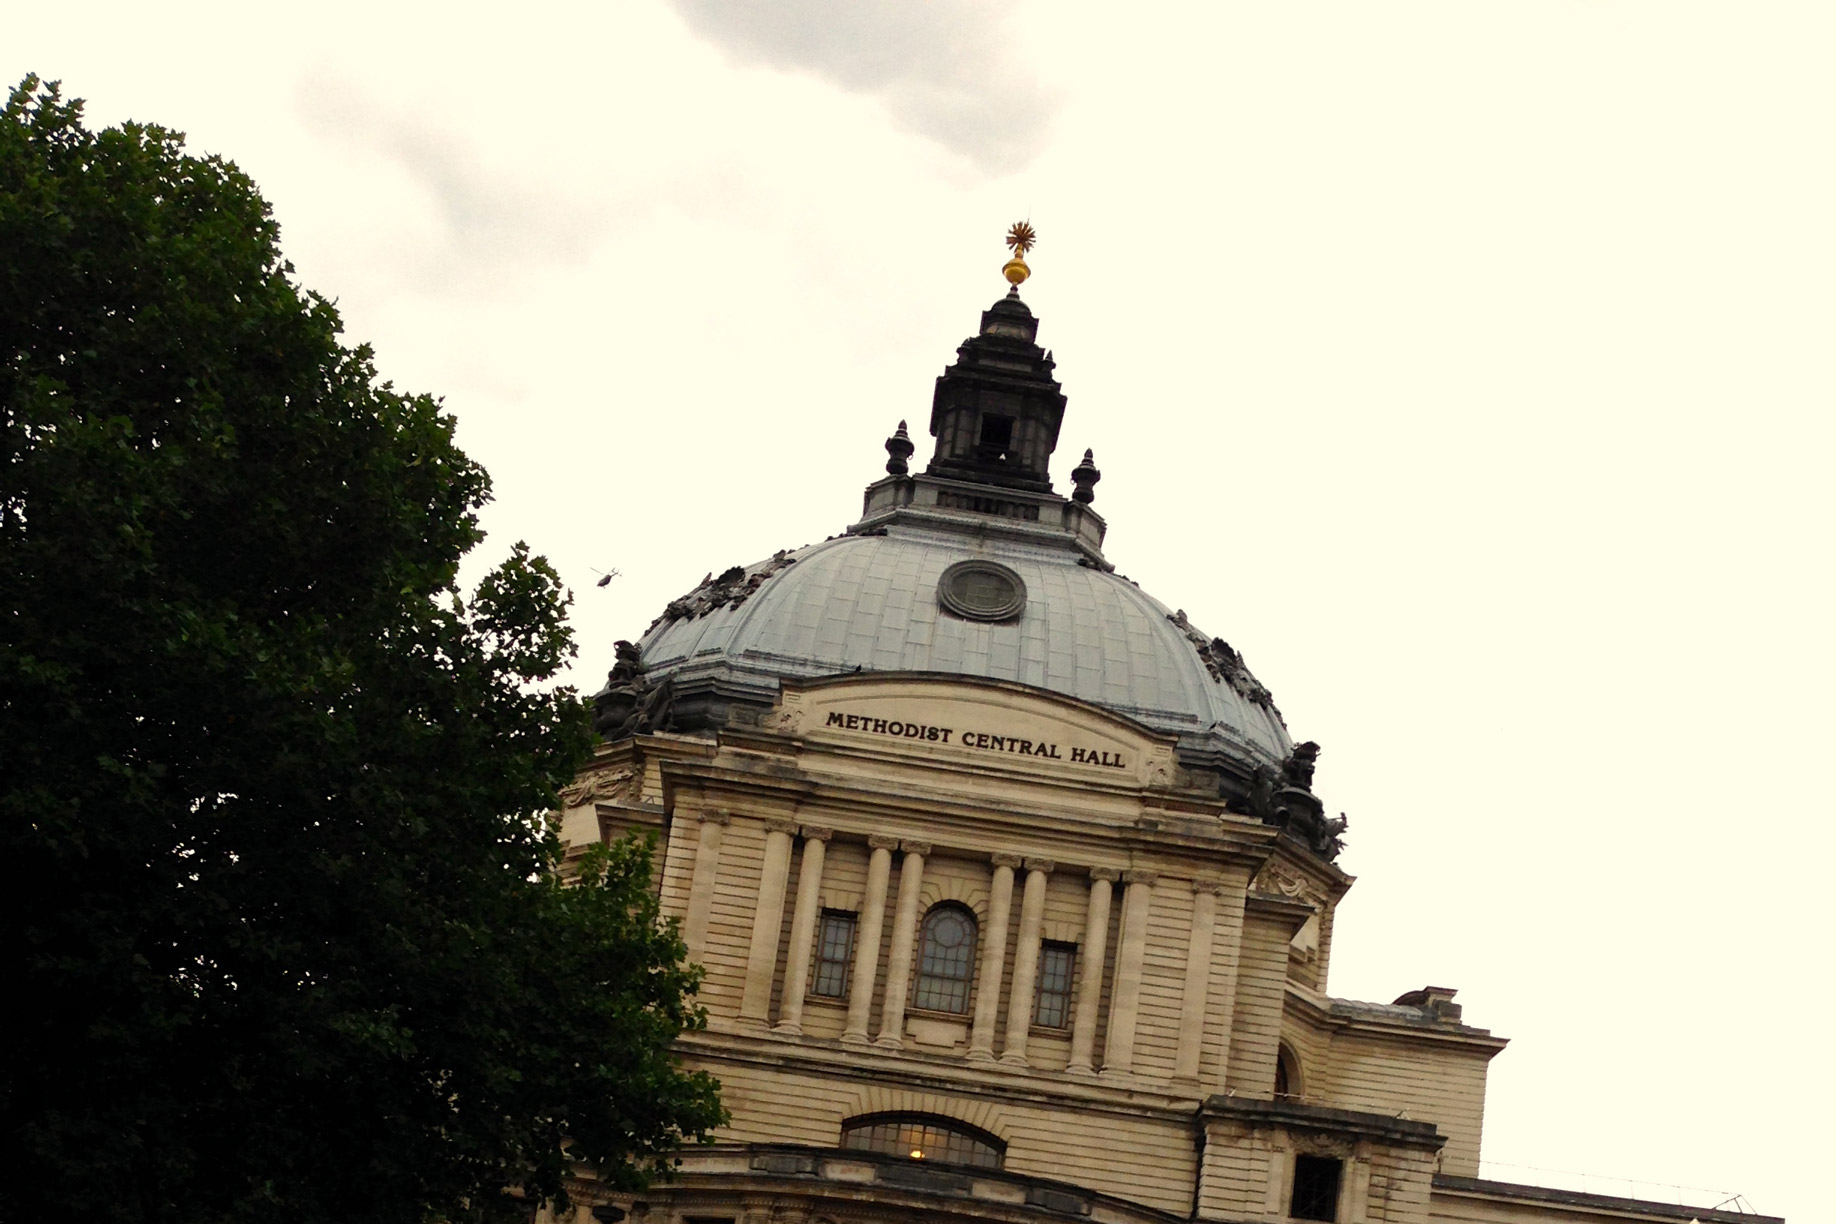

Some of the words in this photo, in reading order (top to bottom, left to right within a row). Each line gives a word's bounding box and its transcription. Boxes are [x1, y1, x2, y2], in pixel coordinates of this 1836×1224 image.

[826, 712, 953, 743] METHODIST
[962, 732, 1061, 759] CENTRAL
[1070, 748, 1126, 769] HALL
